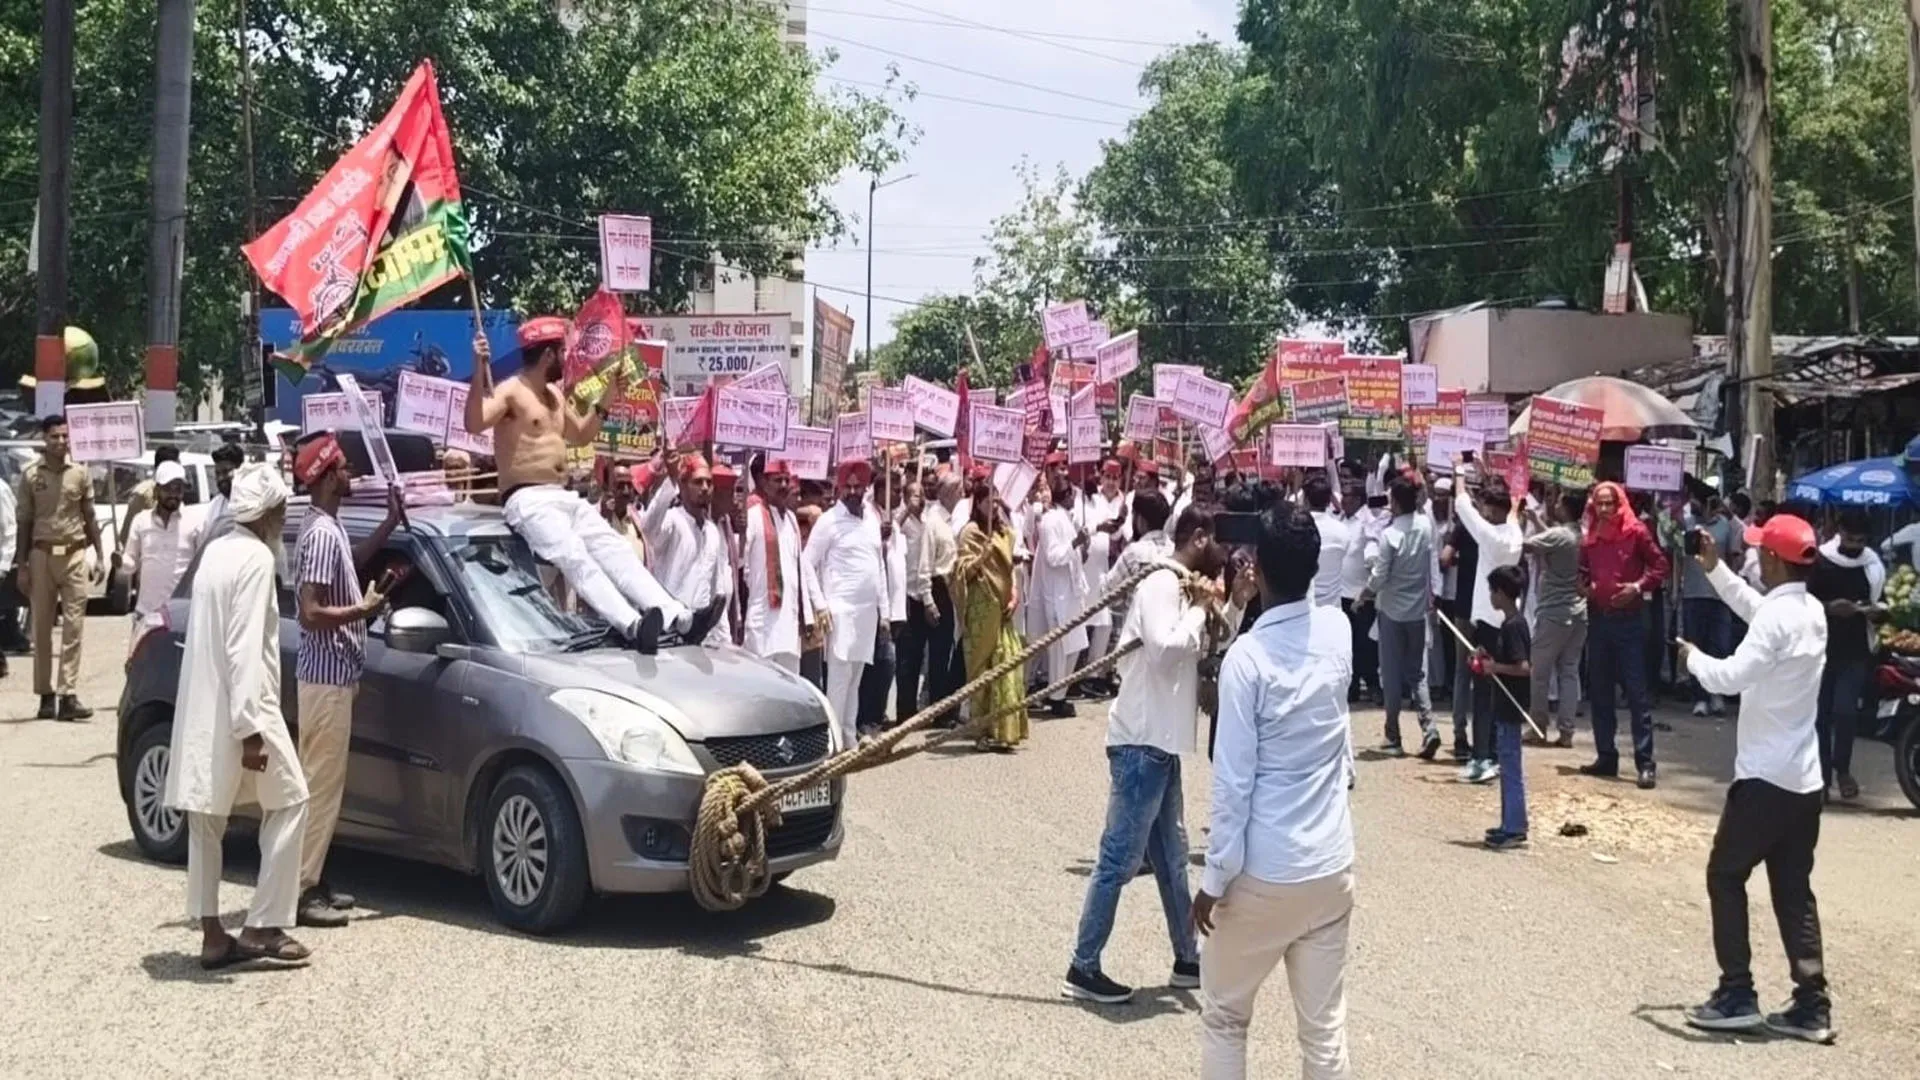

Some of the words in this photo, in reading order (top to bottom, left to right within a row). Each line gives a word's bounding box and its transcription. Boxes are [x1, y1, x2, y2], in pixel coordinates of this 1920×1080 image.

[689, 320, 730, 337] राह-वीर
[734, 319, 770, 337] योजना
[1842, 489, 1891, 504] PEPSI
